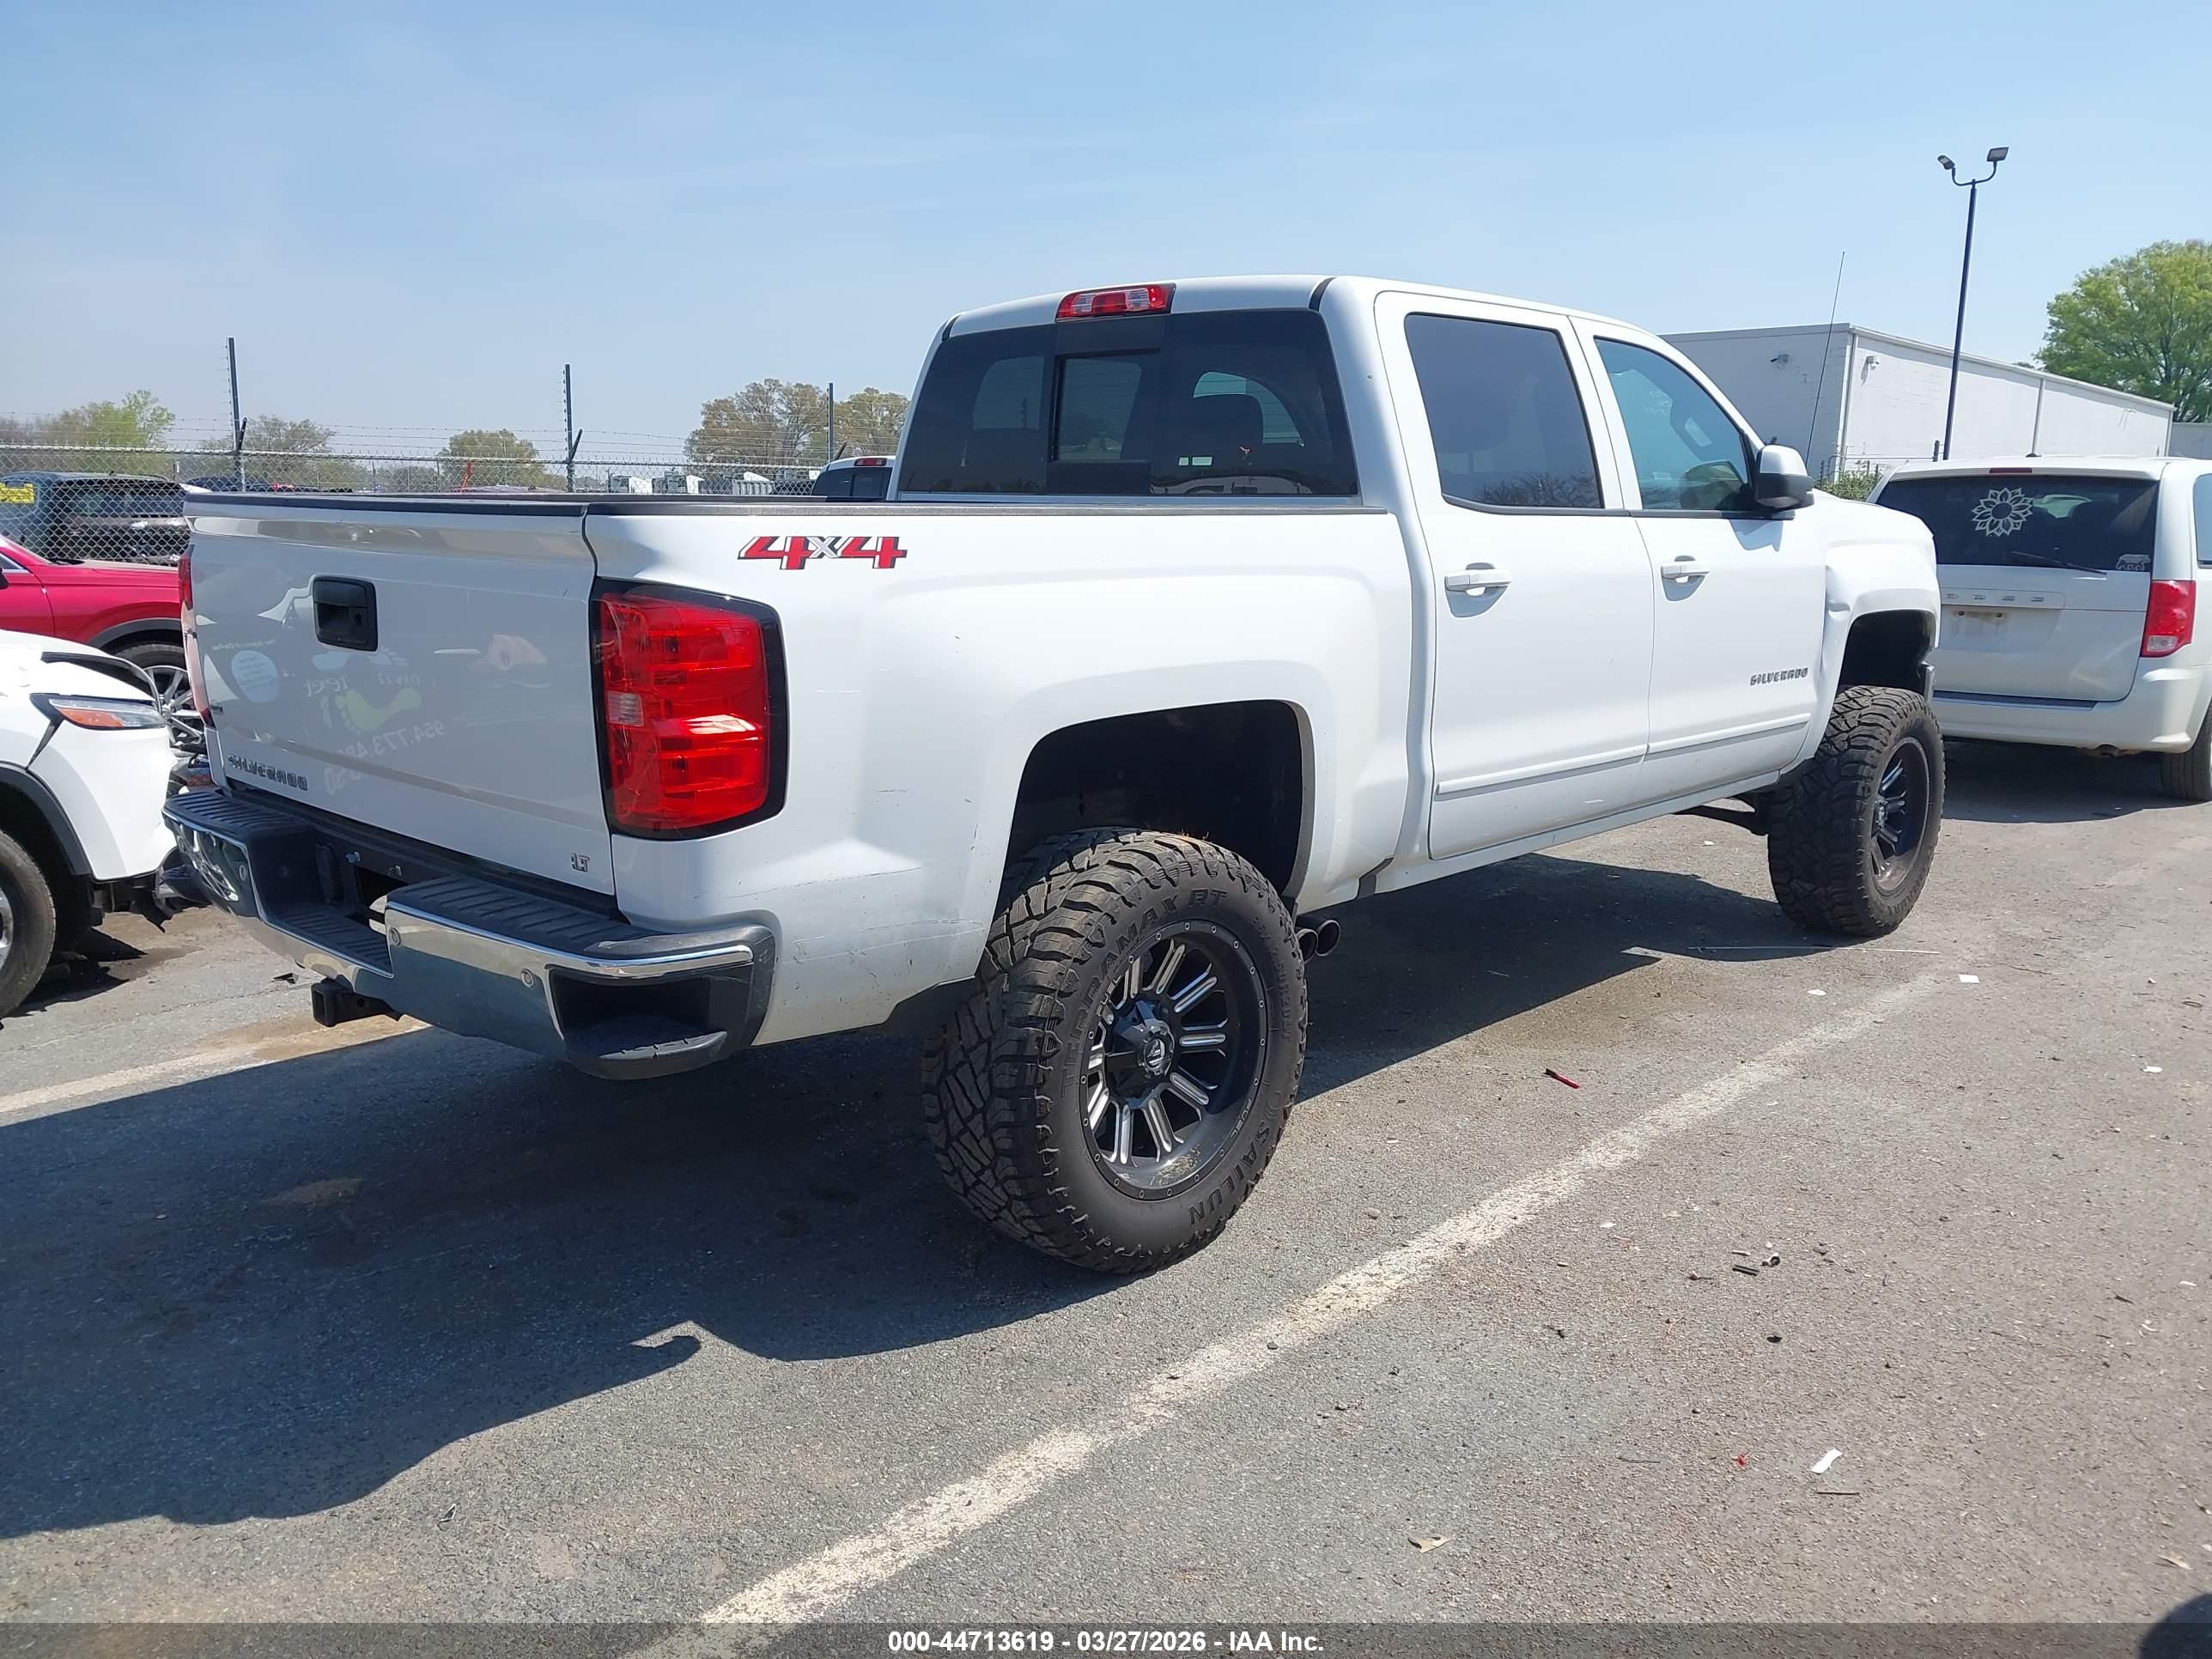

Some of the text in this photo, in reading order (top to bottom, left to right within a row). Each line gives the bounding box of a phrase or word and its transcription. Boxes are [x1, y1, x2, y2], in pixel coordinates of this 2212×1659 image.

[1749, 667, 1808, 687] SILVERADO
[228, 755, 308, 792] SILVERADO
[571, 852, 591, 872] LT
[1060, 888, 1229, 1098] TERRAMAX RT
[1230, 1098, 1252, 1139] FUEL
[1188, 1120, 1271, 1225] SAILUN
